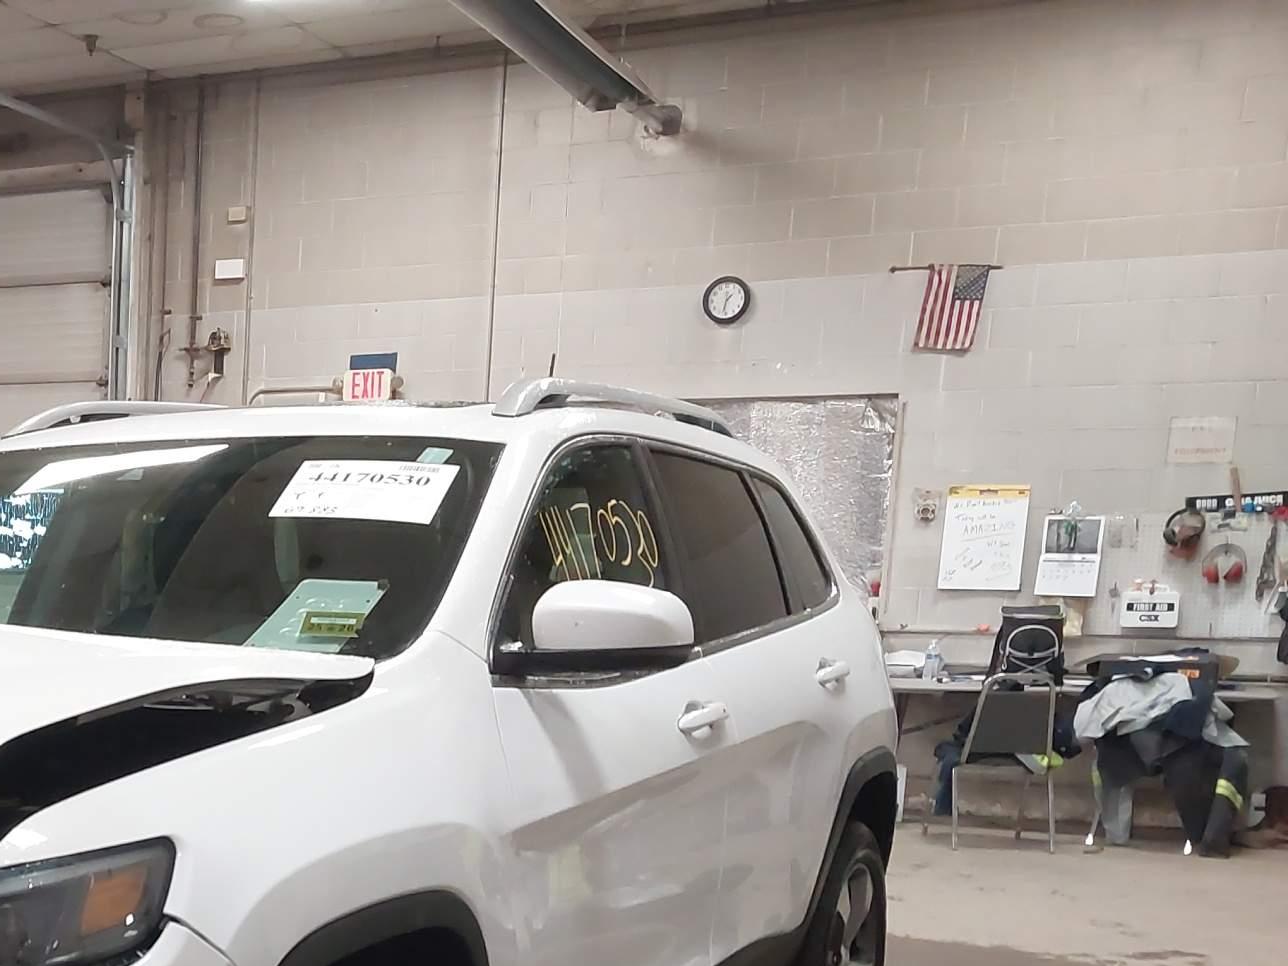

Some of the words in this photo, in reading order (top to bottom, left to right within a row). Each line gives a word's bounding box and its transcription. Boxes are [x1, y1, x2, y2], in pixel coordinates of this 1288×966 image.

[351, 371, 384, 399] EXIT
[308, 471, 431, 487] 44170530
[538, 499, 659, 588] 44170530
